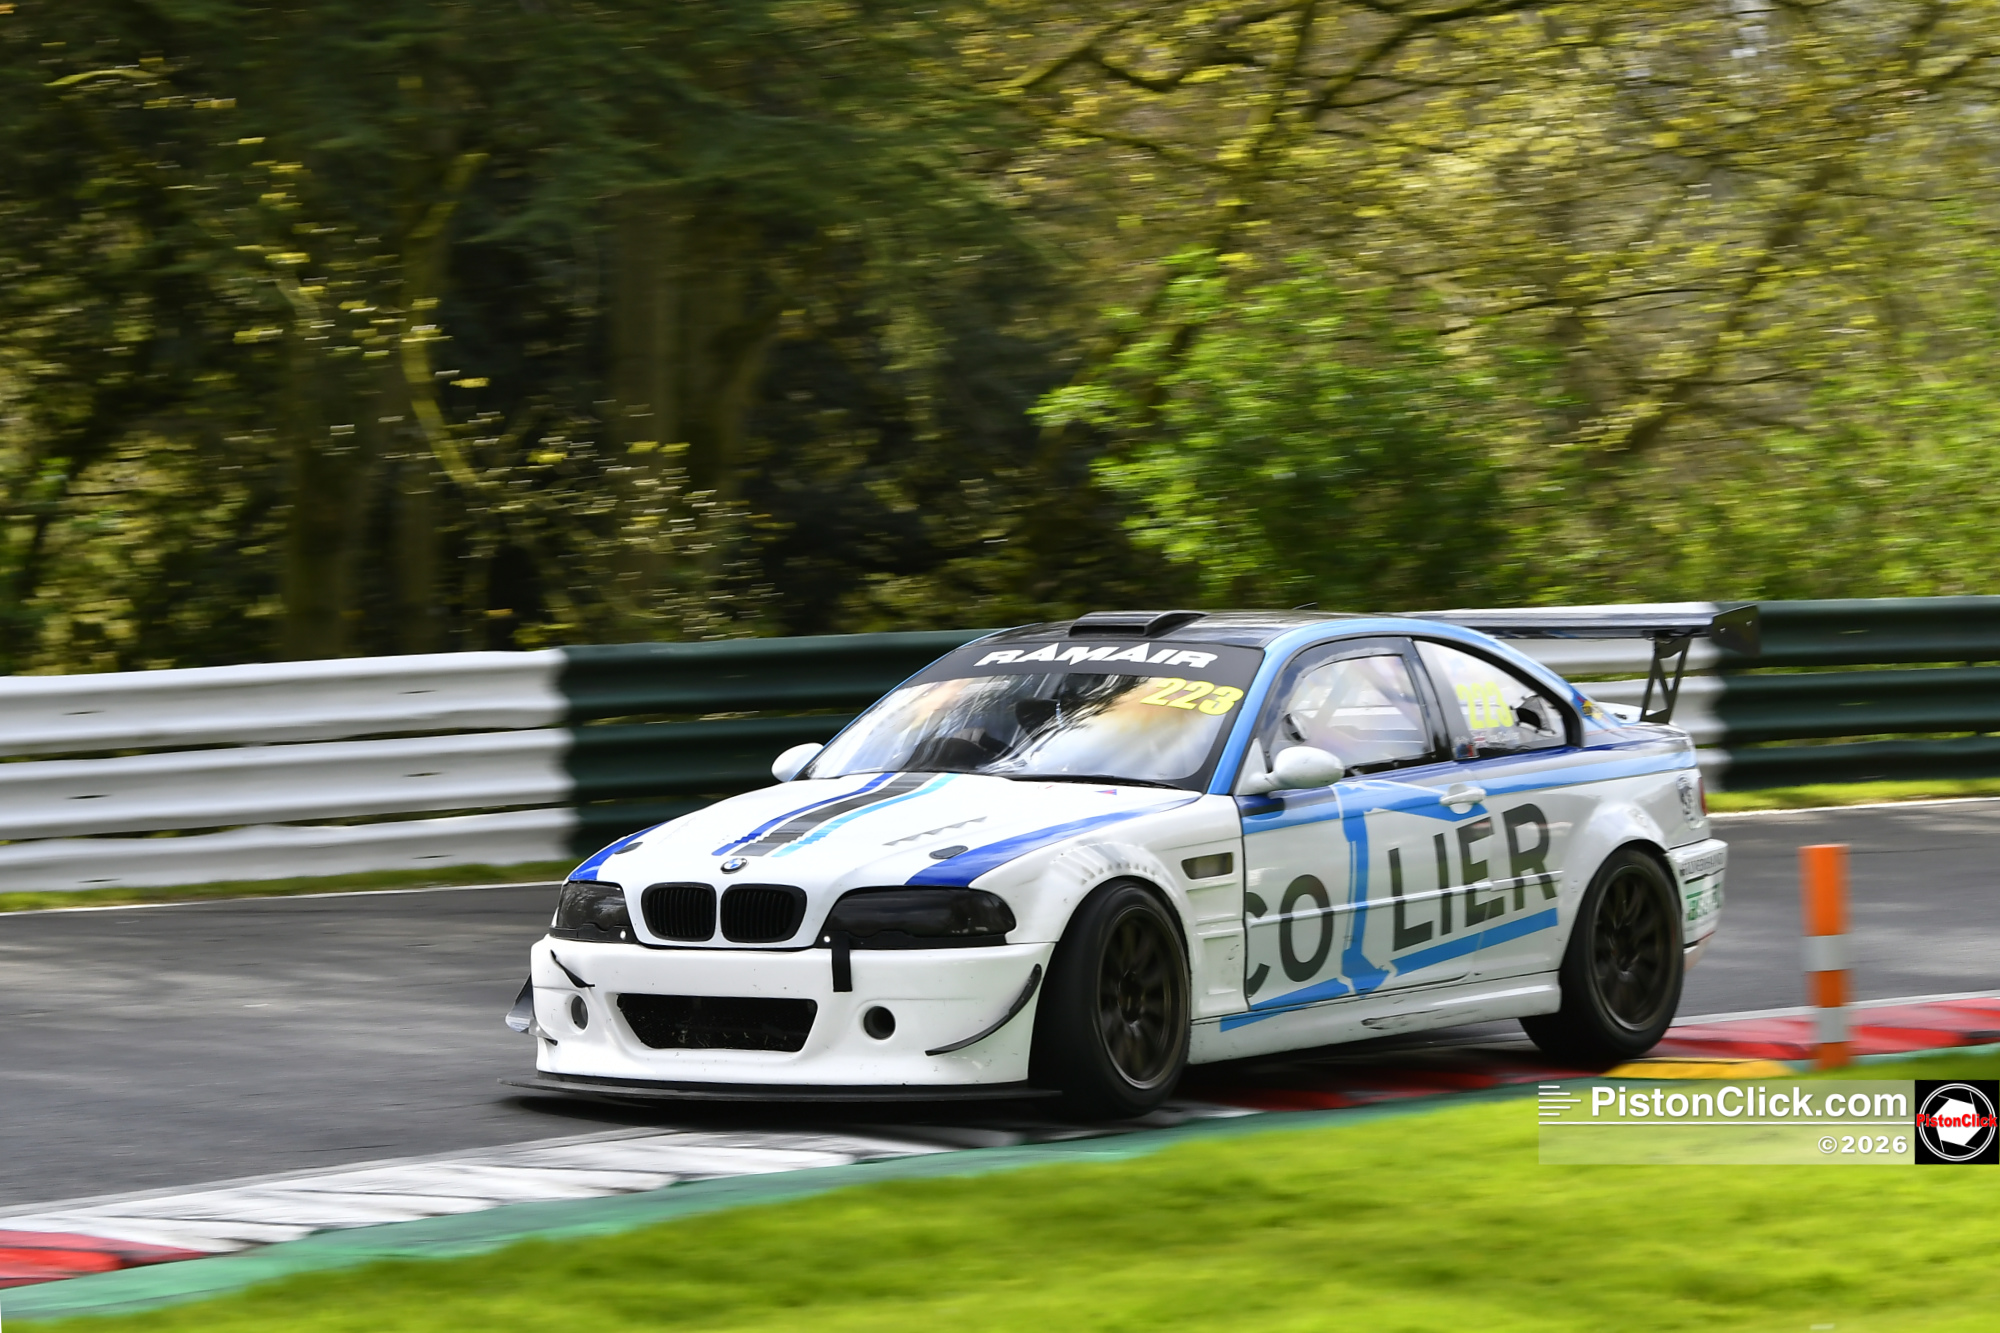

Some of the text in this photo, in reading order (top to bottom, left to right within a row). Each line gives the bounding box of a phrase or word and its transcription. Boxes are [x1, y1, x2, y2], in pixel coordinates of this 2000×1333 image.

[973, 642, 1218, 668] RAMAIR
[1140, 677, 1244, 715] 223
[1455, 681, 1514, 730] 223
